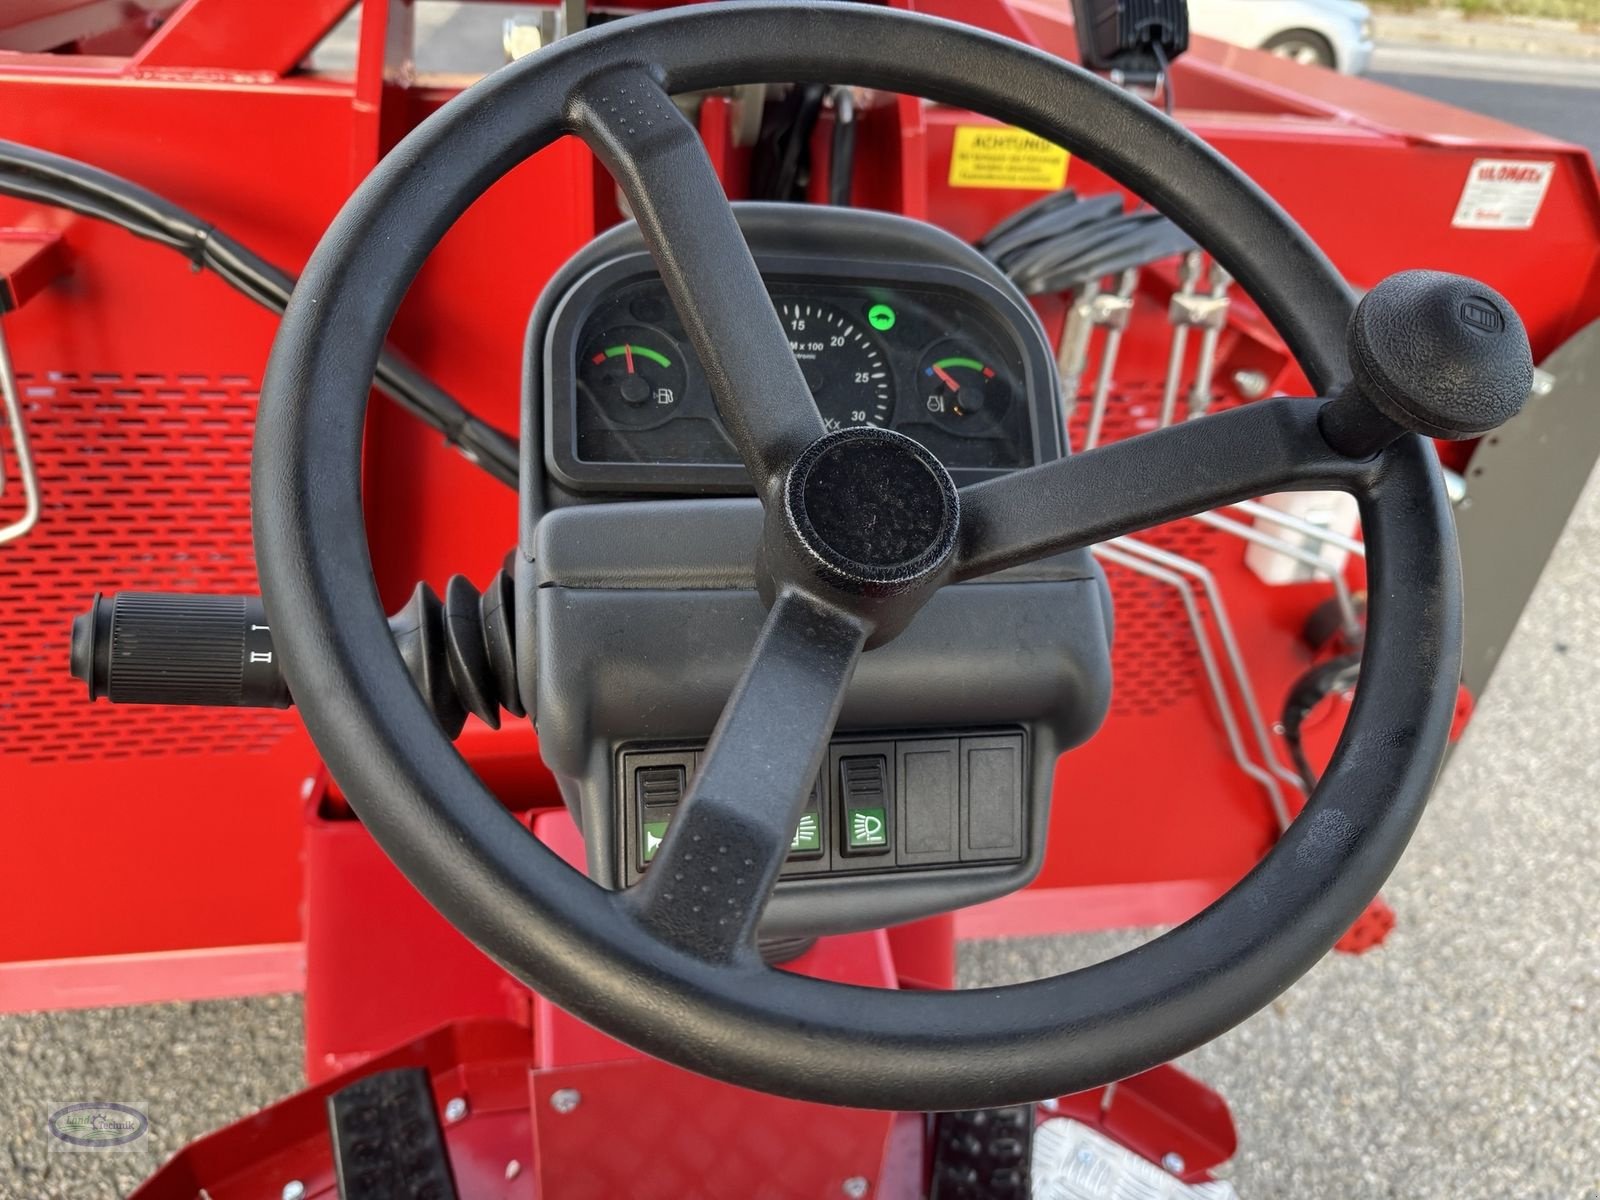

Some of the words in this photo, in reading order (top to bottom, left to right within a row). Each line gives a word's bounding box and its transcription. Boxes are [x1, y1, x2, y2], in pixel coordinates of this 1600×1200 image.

[791, 320, 806, 331] 15
[799, 343, 806, 351] x
[807, 342, 824, 352] 100
[830, 336, 845, 347] 20
[855, 372, 870, 383] 25
[851, 410, 866, 422] 30
